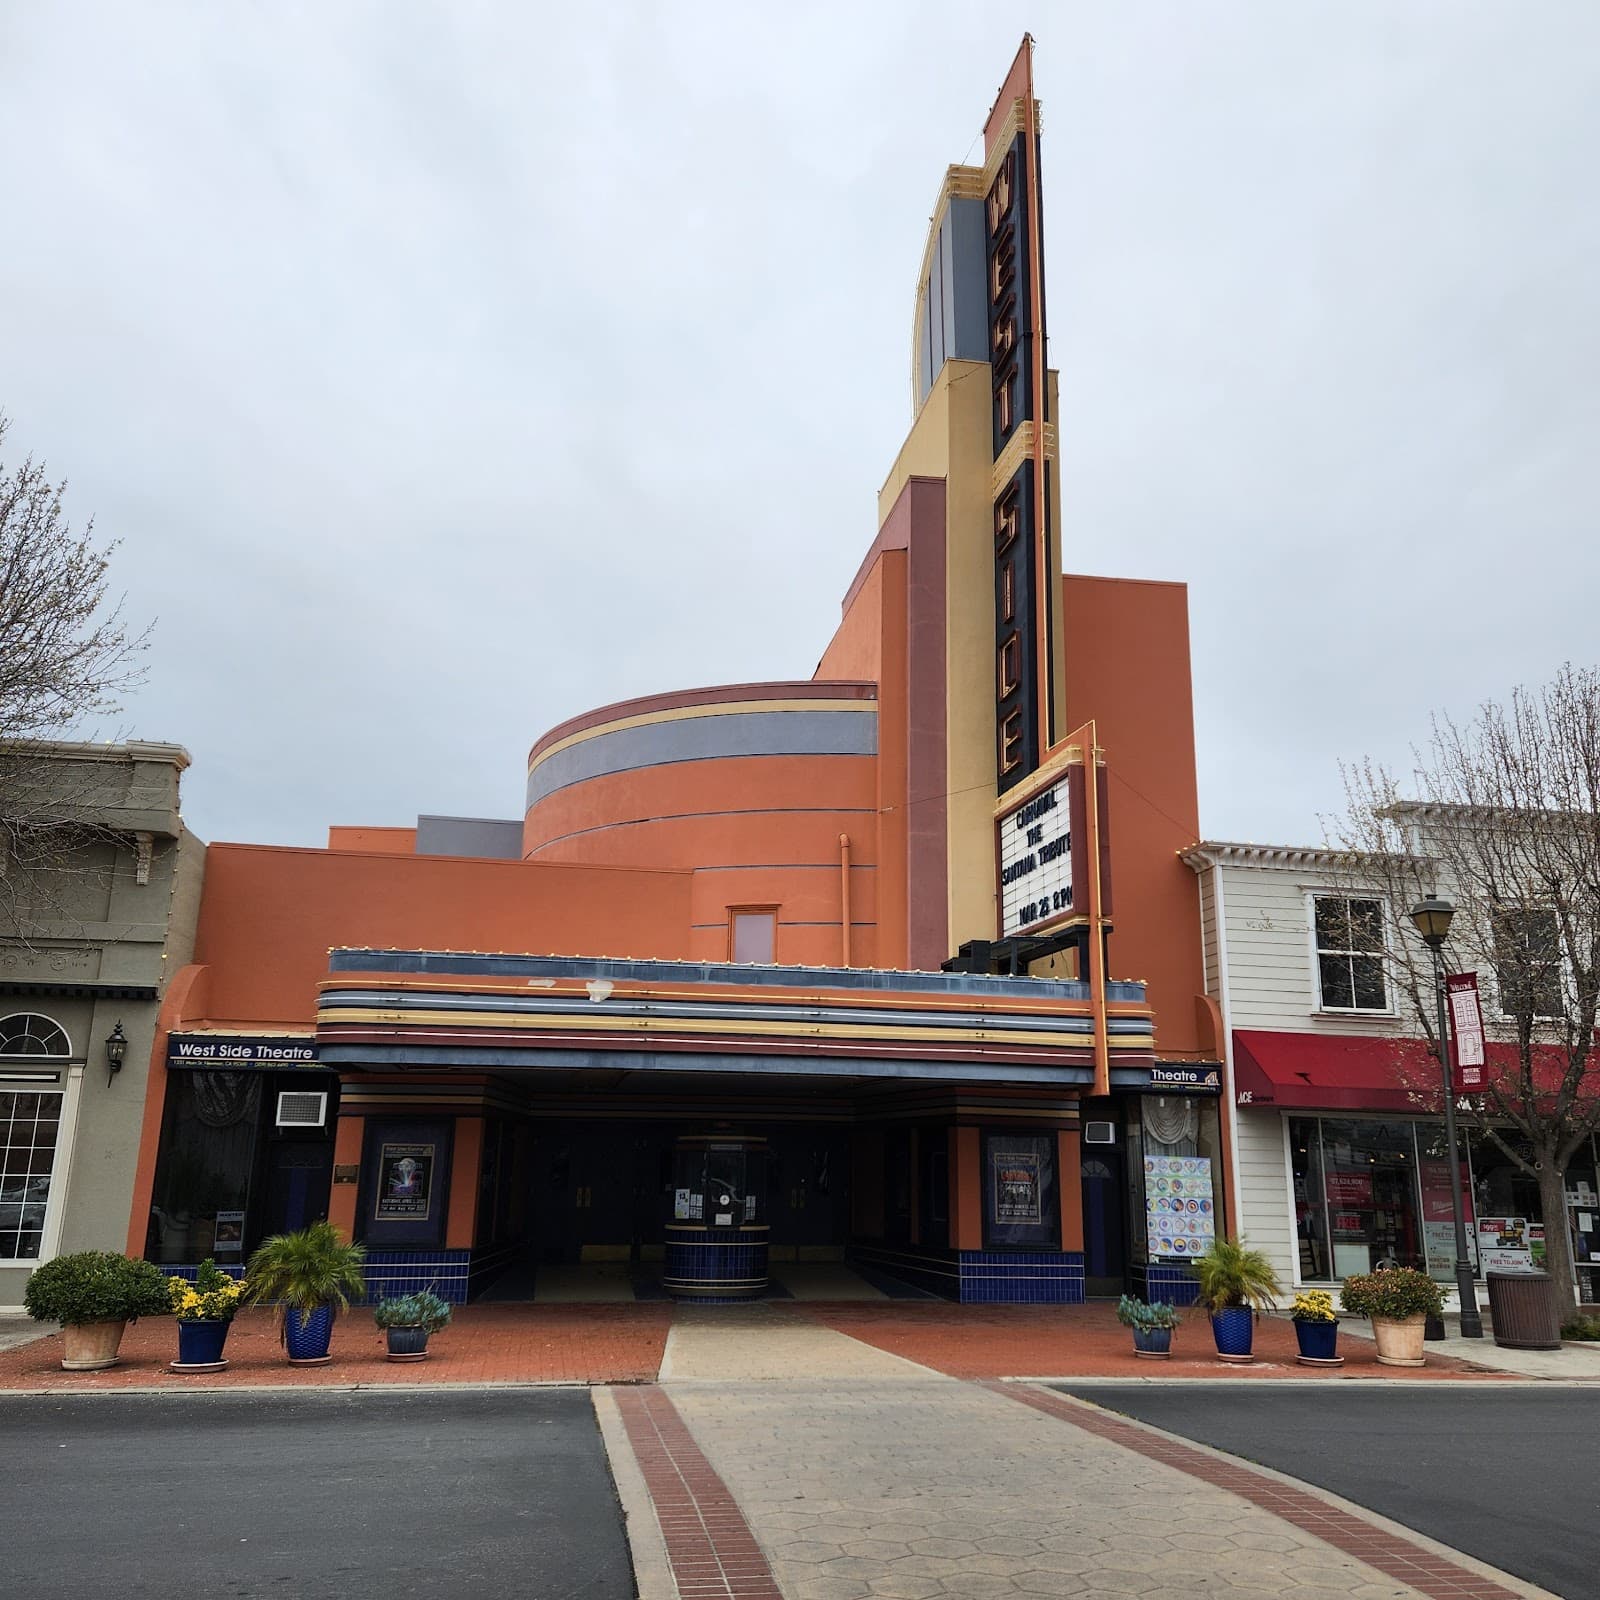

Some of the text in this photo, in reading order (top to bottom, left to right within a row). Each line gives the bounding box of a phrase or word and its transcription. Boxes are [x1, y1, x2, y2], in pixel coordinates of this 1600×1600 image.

[988, 150, 1022, 776] WEST SIDE
[1016, 790, 1058, 829] CARNAVAL
[1027, 823, 1044, 848] THE
[1002, 831, 1071, 886] SANTANA TRIBUTE
[179, 1043, 313, 1059] West Side Theatre
[1151, 1068, 1198, 1082] Theatre
[1237, 1091, 1253, 1104] ACE
